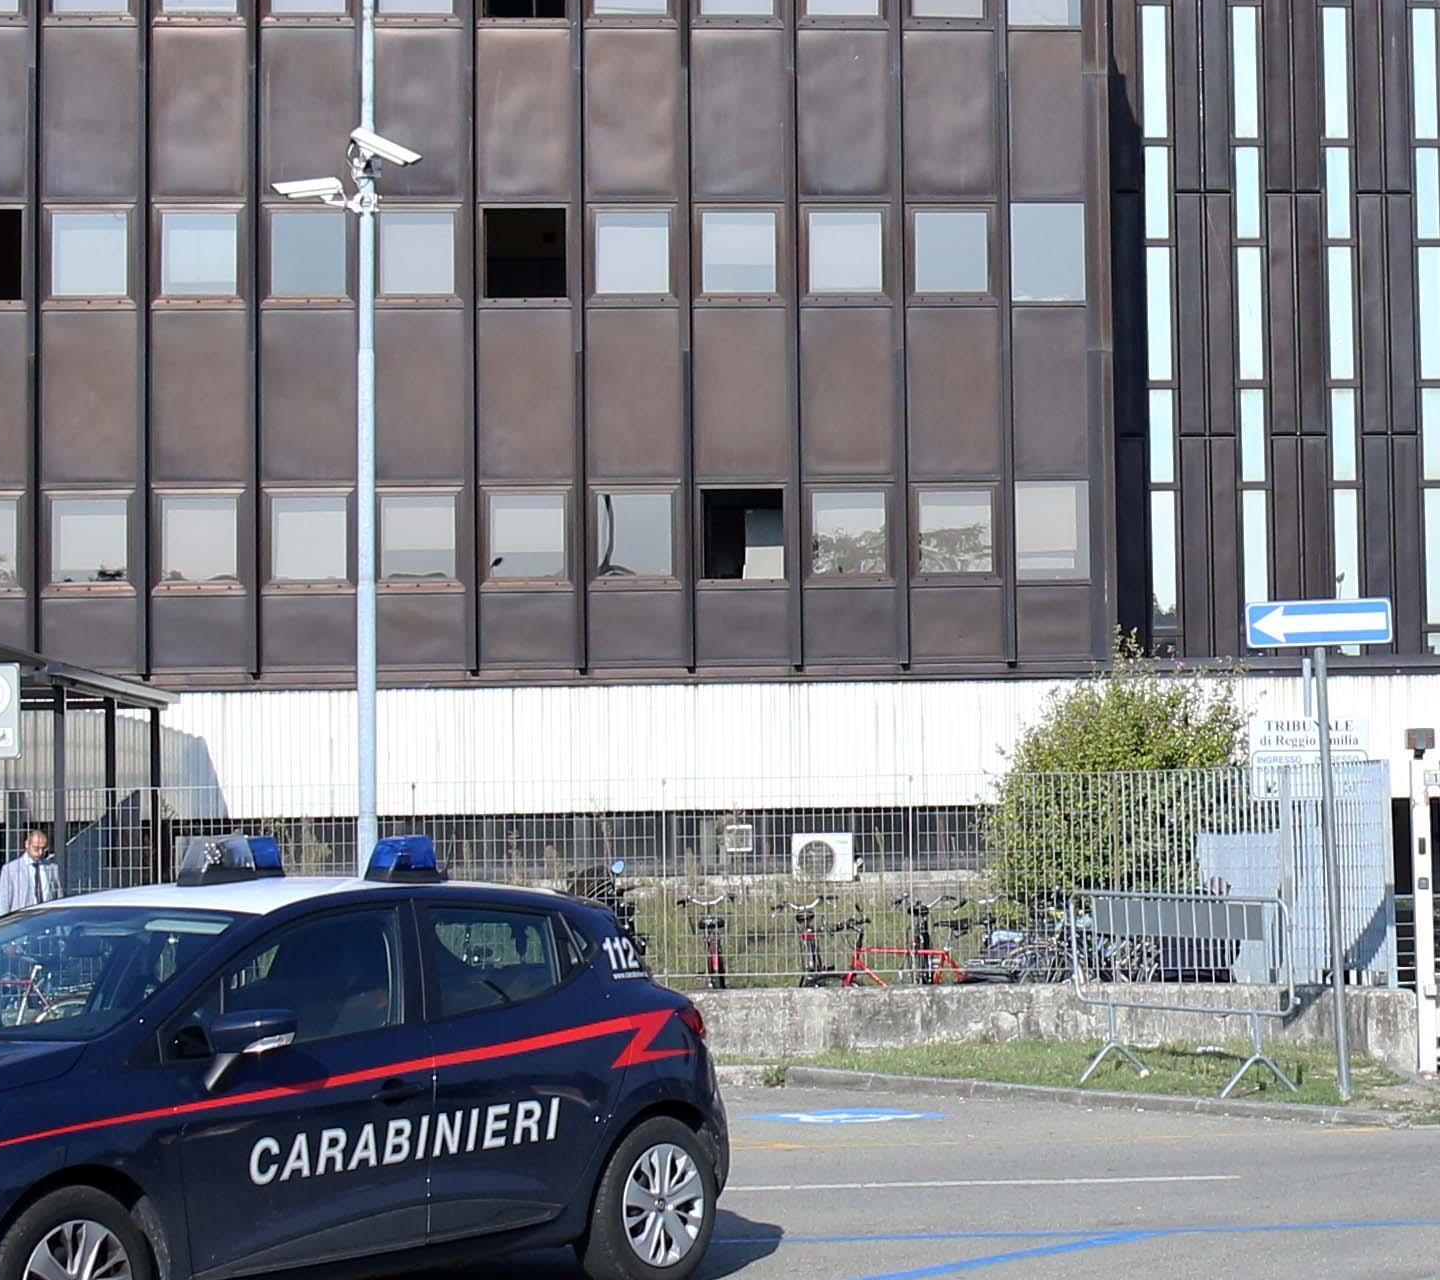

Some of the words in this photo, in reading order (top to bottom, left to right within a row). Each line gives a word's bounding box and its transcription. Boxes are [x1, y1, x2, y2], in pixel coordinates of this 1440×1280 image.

[1259, 734, 1272, 746] di
[1276, 734, 1316, 748] Reggio
[1328, 734, 1359, 746] milia
[601, 936, 641, 970] 112
[248, 1096, 560, 1186] CARABINIERI
